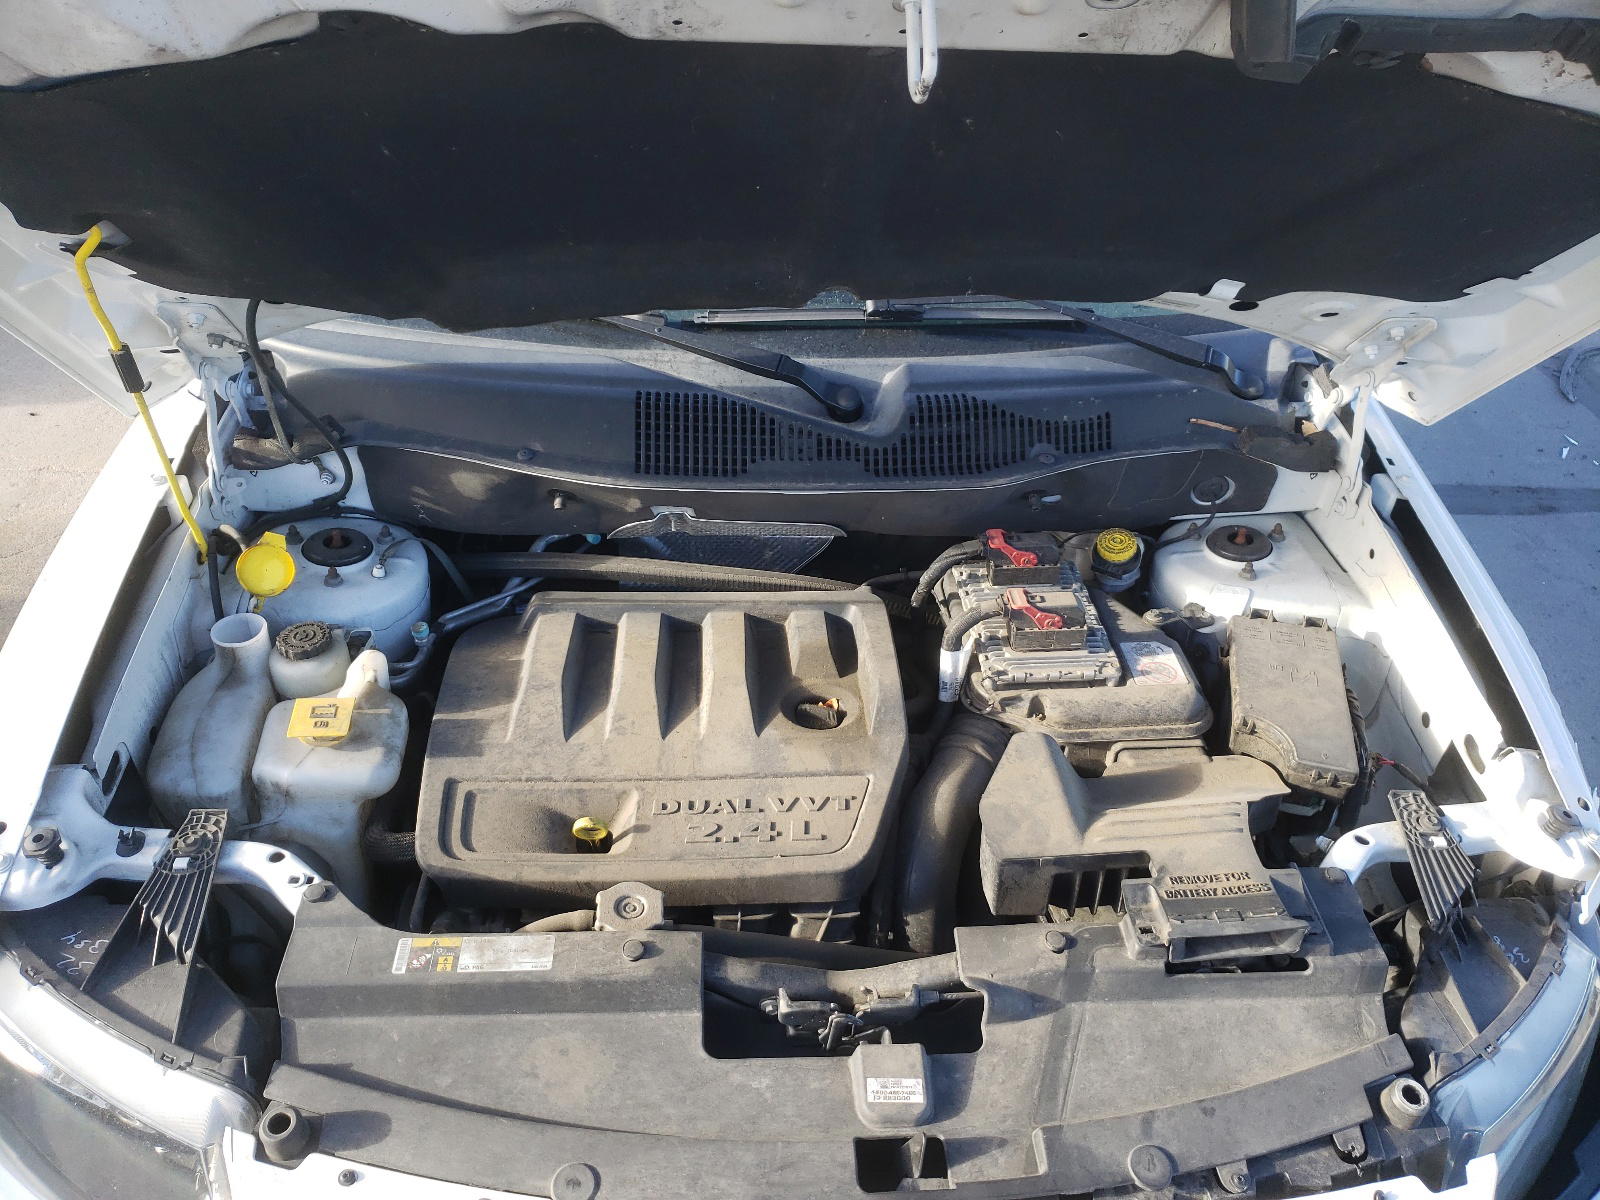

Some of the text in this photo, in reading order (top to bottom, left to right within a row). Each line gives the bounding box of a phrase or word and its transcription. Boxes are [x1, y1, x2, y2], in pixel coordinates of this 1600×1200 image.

[652, 795, 857, 815] DUAL VVT
[1168, 871, 1251, 885] REMOVE FOR
[1164, 883, 1272, 899] BATTERY ACCESS
